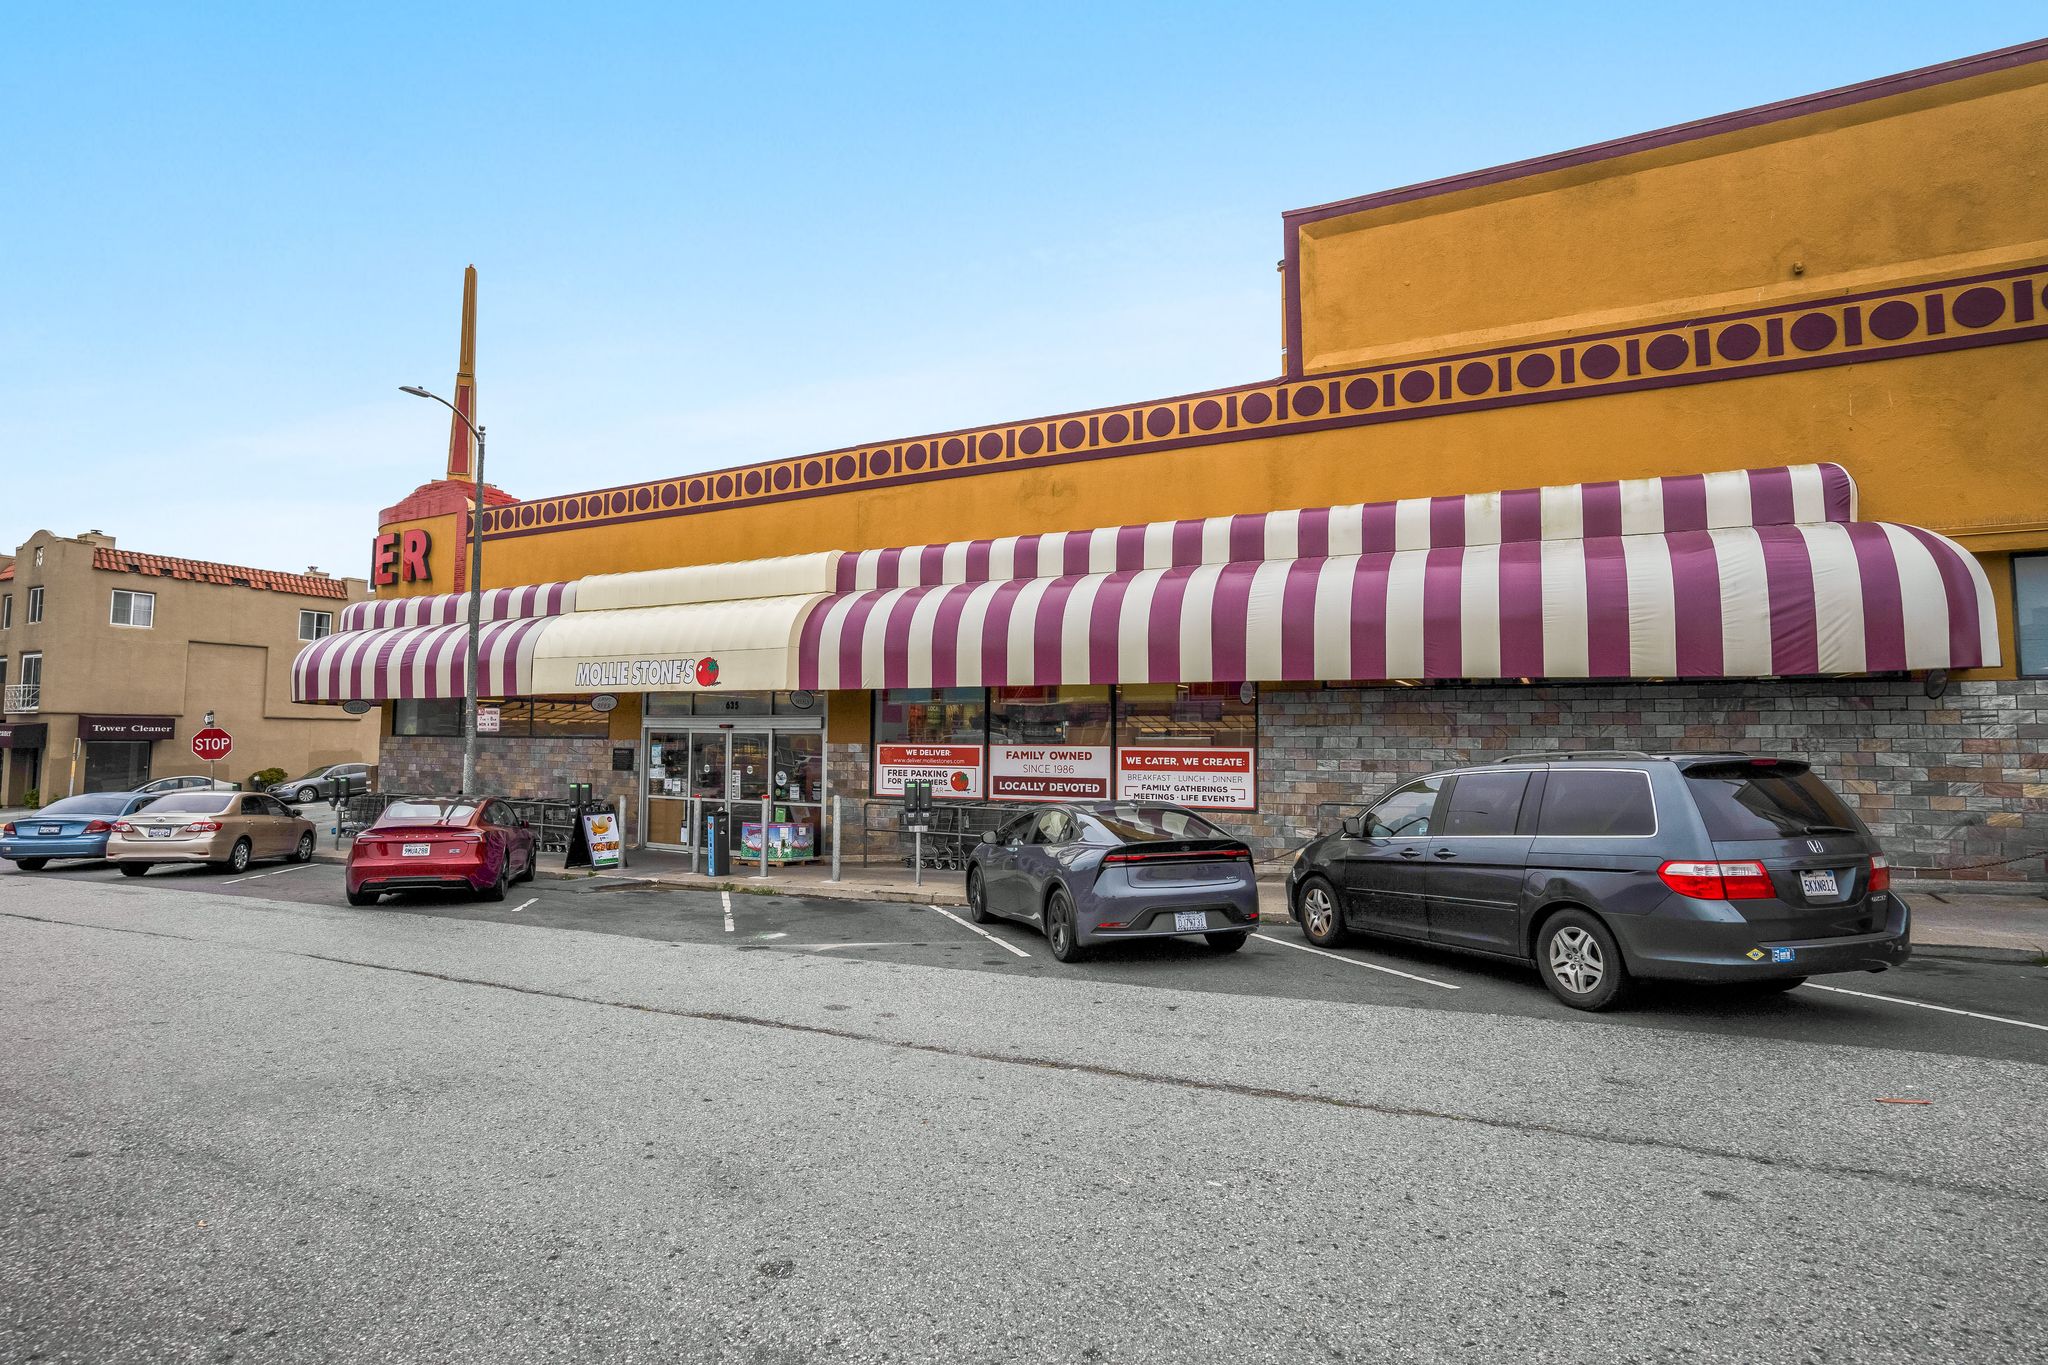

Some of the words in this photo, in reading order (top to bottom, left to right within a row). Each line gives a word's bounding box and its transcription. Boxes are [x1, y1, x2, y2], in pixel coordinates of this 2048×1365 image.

[575, 661, 629, 686] MOLLIE
[631, 659, 695, 685] STONE'S
[725, 701, 739, 710] 635
[92, 724, 127, 732] Tower
[131, 725, 173, 733] Cleaner
[194, 737, 230, 751] STOP
[1006, 750, 1046, 760] FAMILY
[1049, 751, 1093, 761] OWNED
[1126, 756, 1142, 765] WE
[1144, 757, 1179, 766] CATER,
[1182, 758, 1199, 766] WE
[1202, 758, 1246, 767] CREATE:
[887, 769, 908, 777] FREE
[910, 770, 949, 778] PARKING
[1022, 764, 1051, 774] SINCE
[1053, 764, 1075, 774] 1986
[887, 777, 902, 785] FOR
[1127, 773, 1171, 782] BREAKFAST
[1178, 775, 1205, 783] LUNCH
[1212, 775, 1243, 783] DINNER
[999, 781, 1047, 791] LOCALLY
[1049, 782, 1100, 793] DEVOTED
[1141, 784, 1171, 792] FAMILY
[1173, 784, 1228, 793] GATHERINGS
[1133, 793, 1175, 801] MEETINGS
[1201, 794, 1236, 802] EVENTS
[1805, 879, 1836, 893] 5KXN812
